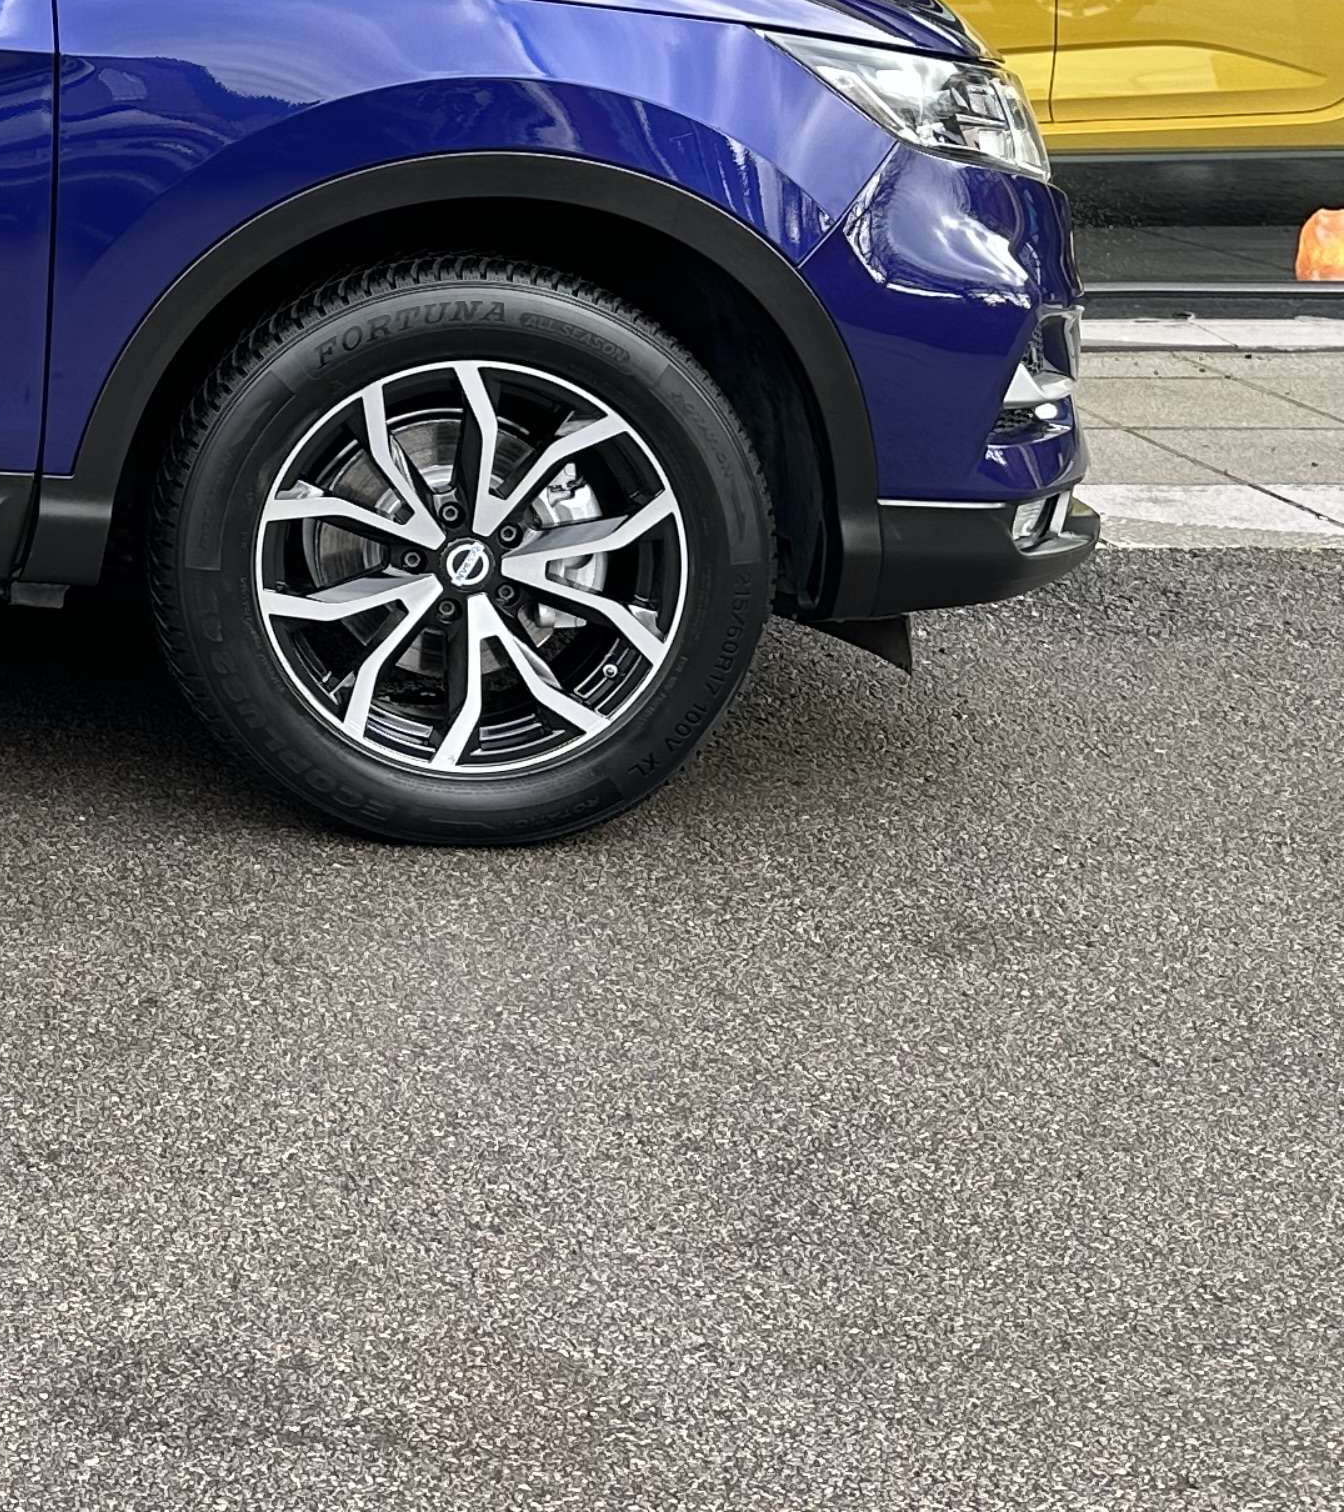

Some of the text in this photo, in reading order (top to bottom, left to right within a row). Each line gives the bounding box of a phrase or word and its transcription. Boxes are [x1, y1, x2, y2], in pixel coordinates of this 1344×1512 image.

[313, 299, 507, 371] FORTUNA
[559, 321, 631, 364] SEASON
[704, 569, 752, 698] 215/60R17
[663, 702, 709, 754] 100V
[626, 751, 661, 778] XL
